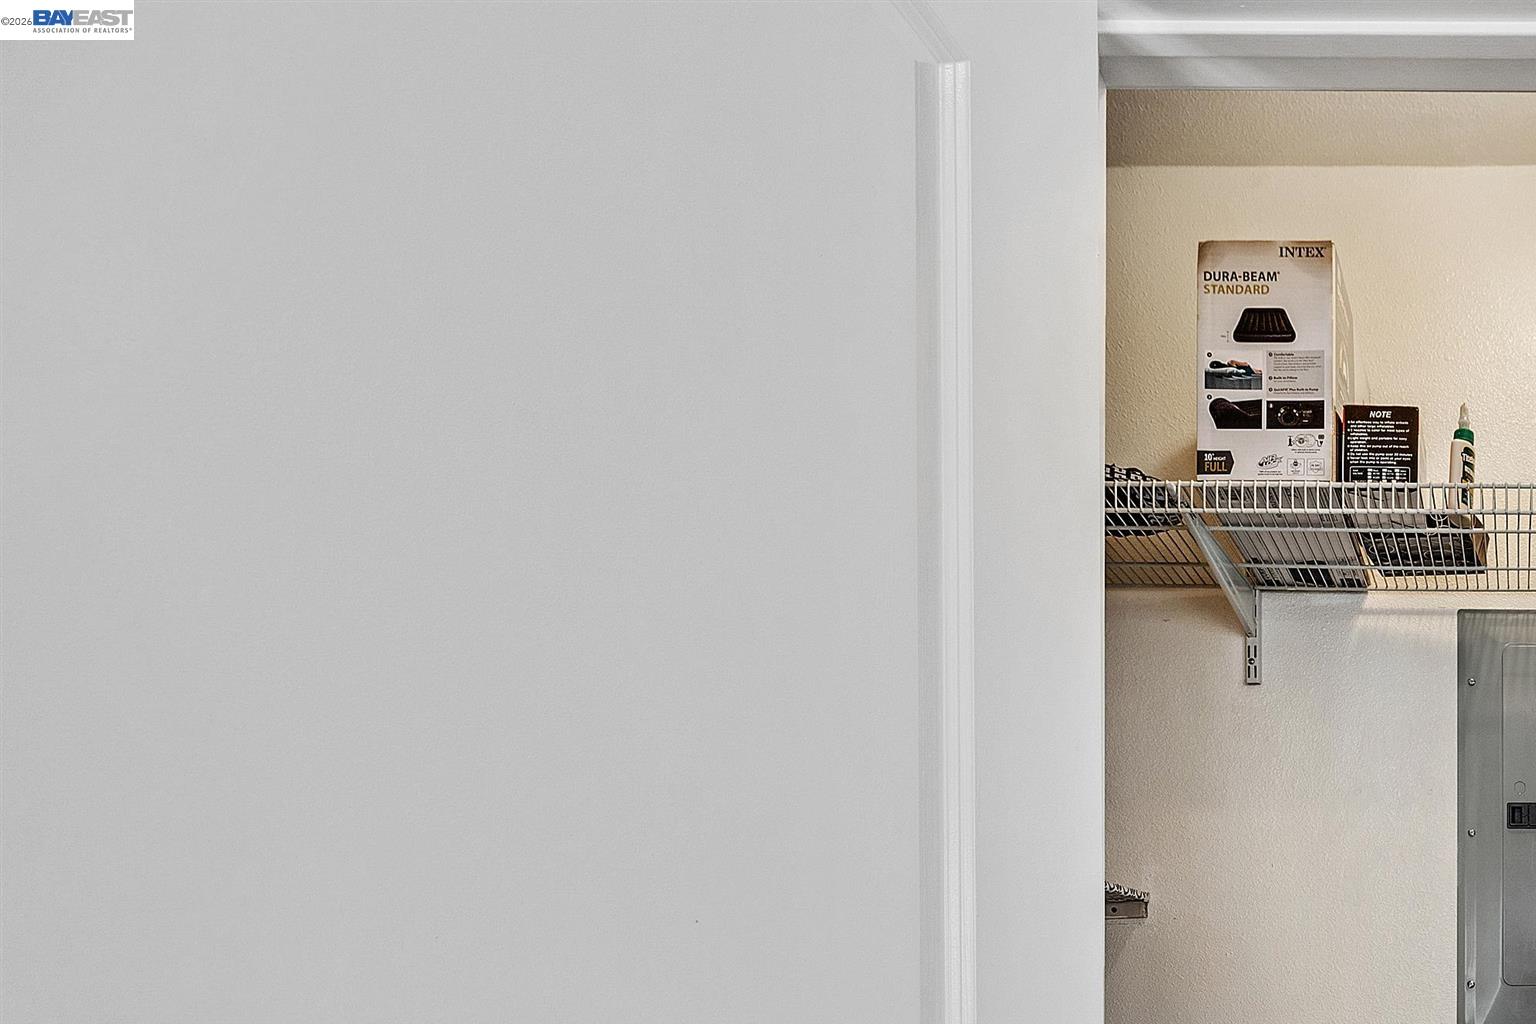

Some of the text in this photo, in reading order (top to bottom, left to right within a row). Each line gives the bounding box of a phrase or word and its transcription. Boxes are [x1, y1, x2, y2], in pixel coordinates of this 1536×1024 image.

[1279, 246, 1325, 258] INTEX
[1203, 284, 1270, 294] STANDARD
[1369, 410, 1392, 418] NOTE
[1204, 461, 1228, 471] FULL
